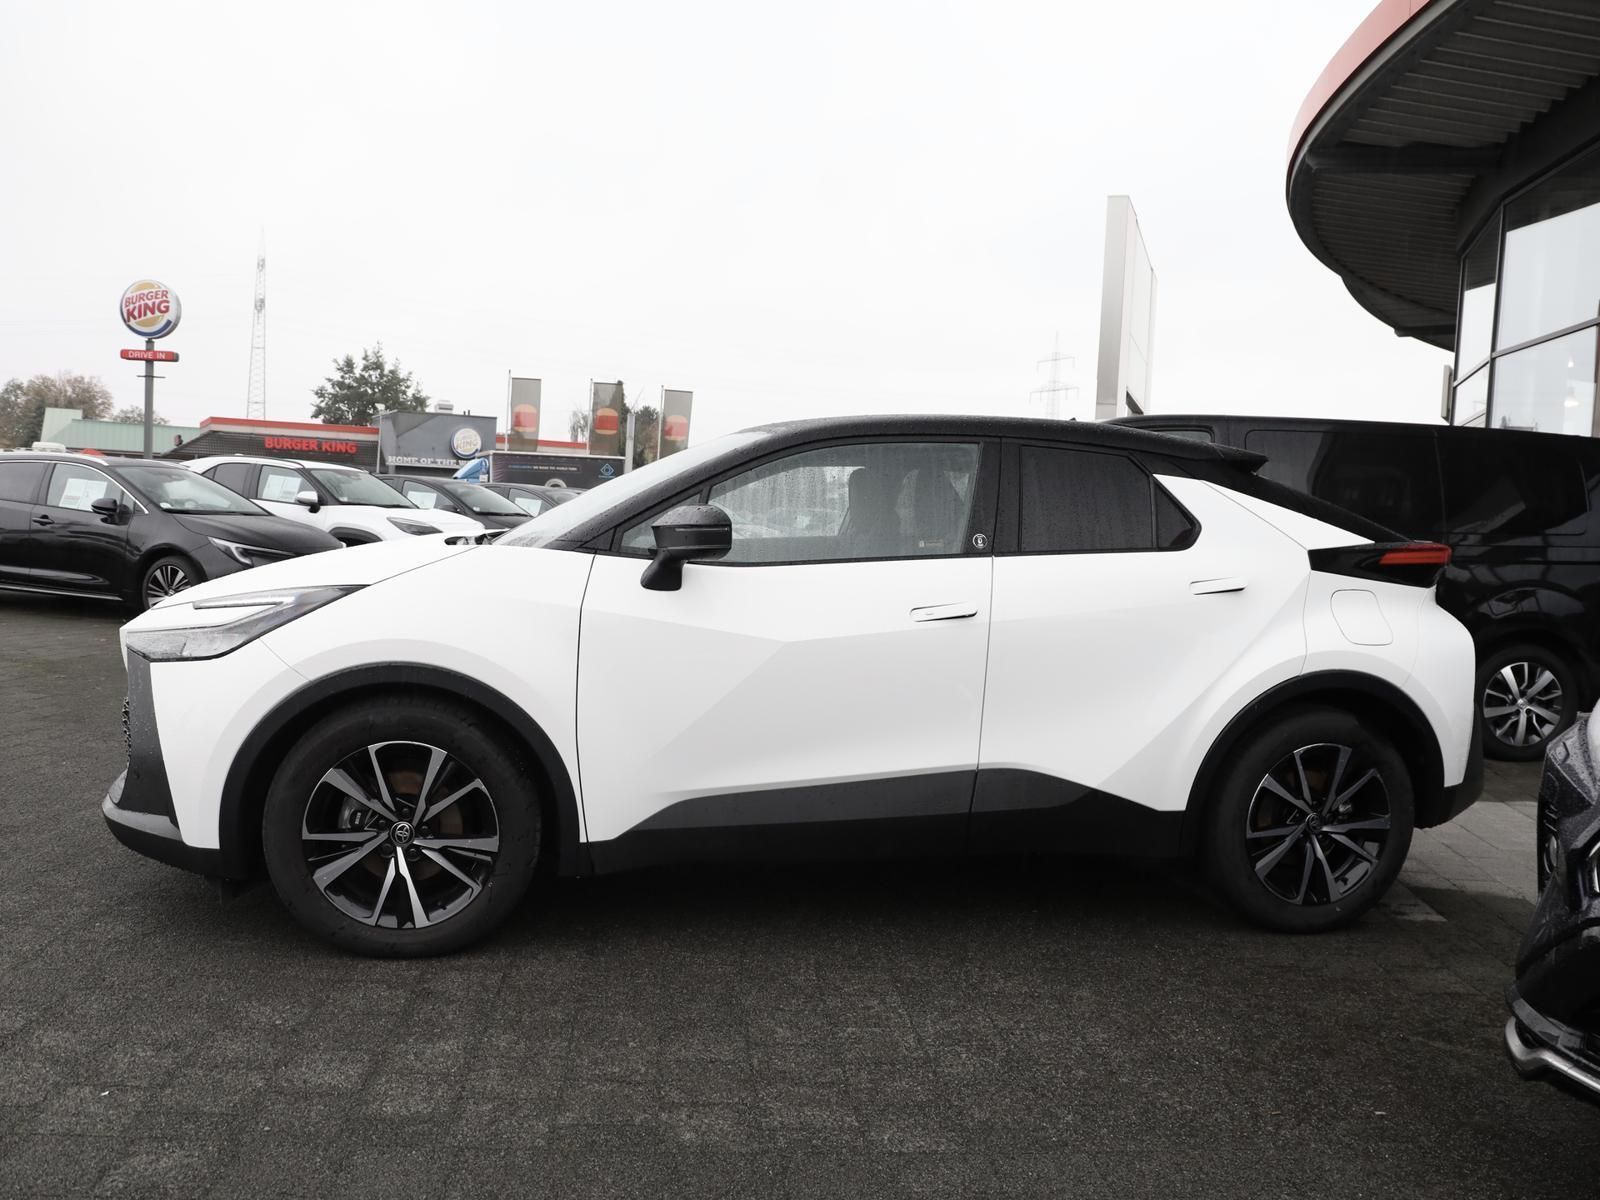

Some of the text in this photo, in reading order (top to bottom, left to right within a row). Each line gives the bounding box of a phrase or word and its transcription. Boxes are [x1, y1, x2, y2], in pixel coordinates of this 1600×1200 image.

[124, 290, 169, 308] BURGER
[126, 299, 170, 322] KING
[128, 351, 153, 359] DRIVE
[264, 436, 357, 453] BURGER KING
[388, 456, 418, 465] HOME
[420, 457, 433, 465] OF
